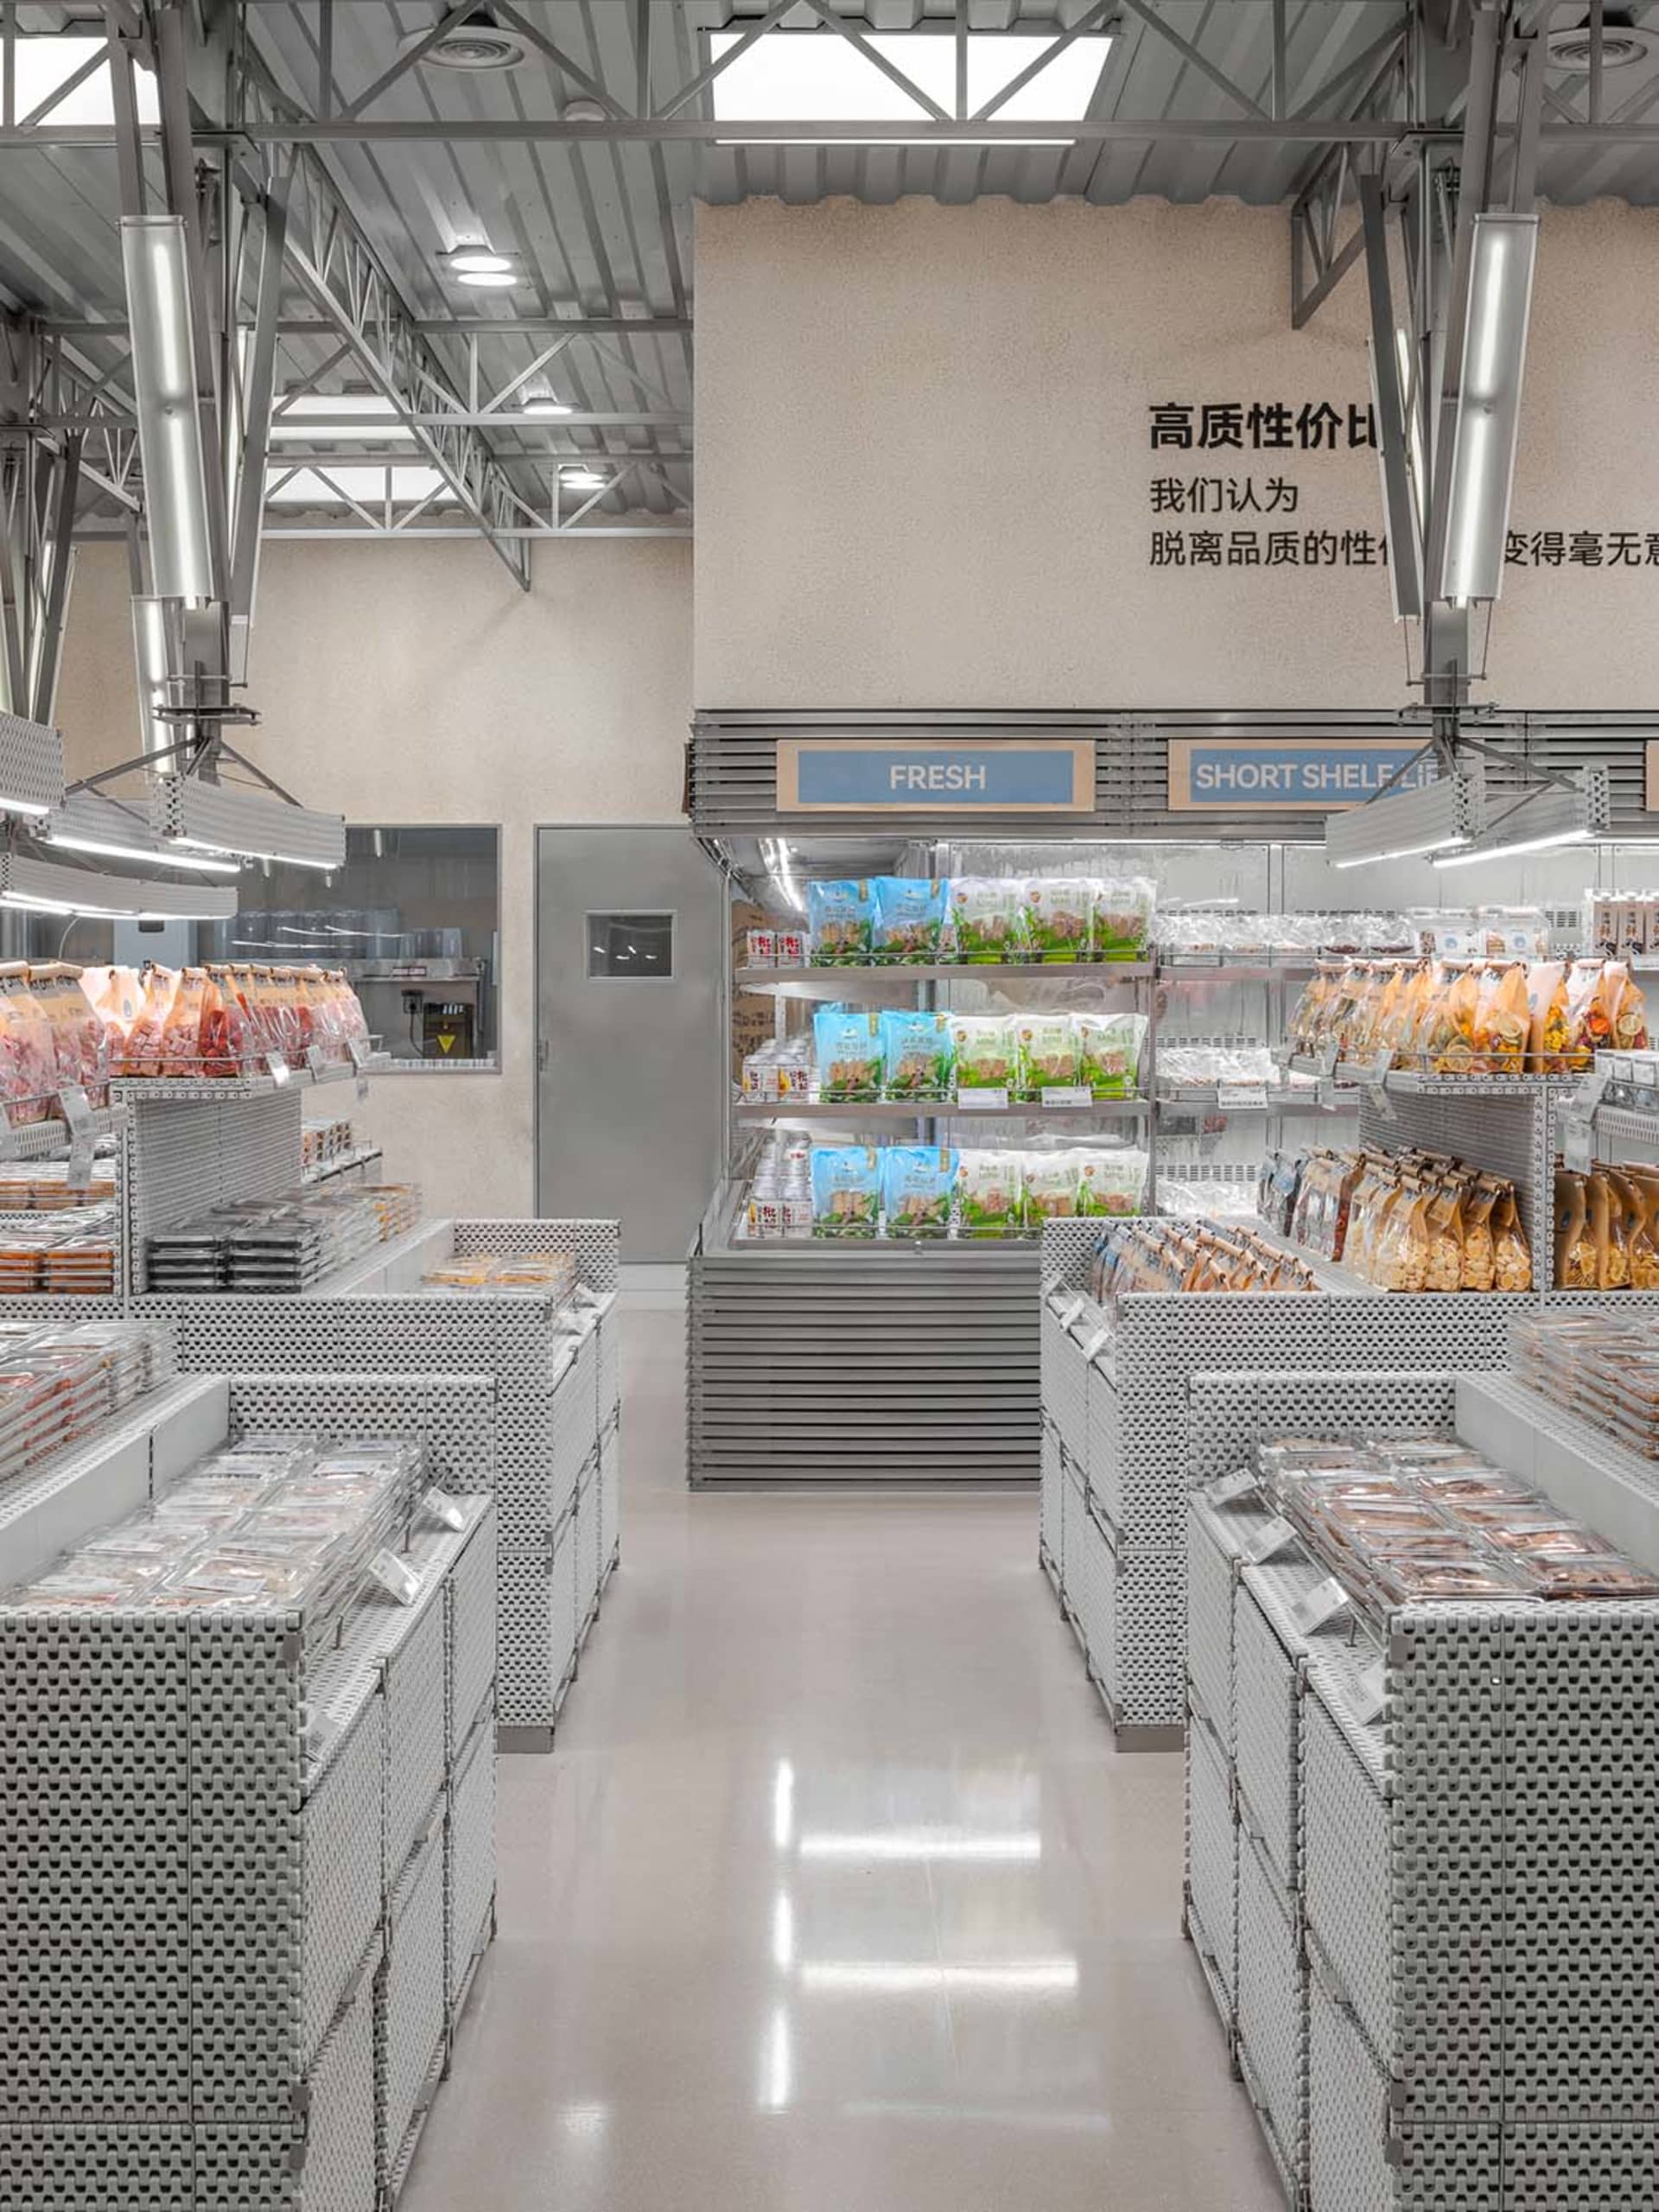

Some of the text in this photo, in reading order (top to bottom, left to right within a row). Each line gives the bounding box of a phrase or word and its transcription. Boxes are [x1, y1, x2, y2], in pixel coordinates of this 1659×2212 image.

[1149, 402, 1378, 449] 高质性价比
[1150, 477, 1299, 513] 我们认为
[889, 765, 987, 790] FRESH
[1195, 764, 1297, 789] SHORT
[1302, 764, 1394, 789] SHELF
